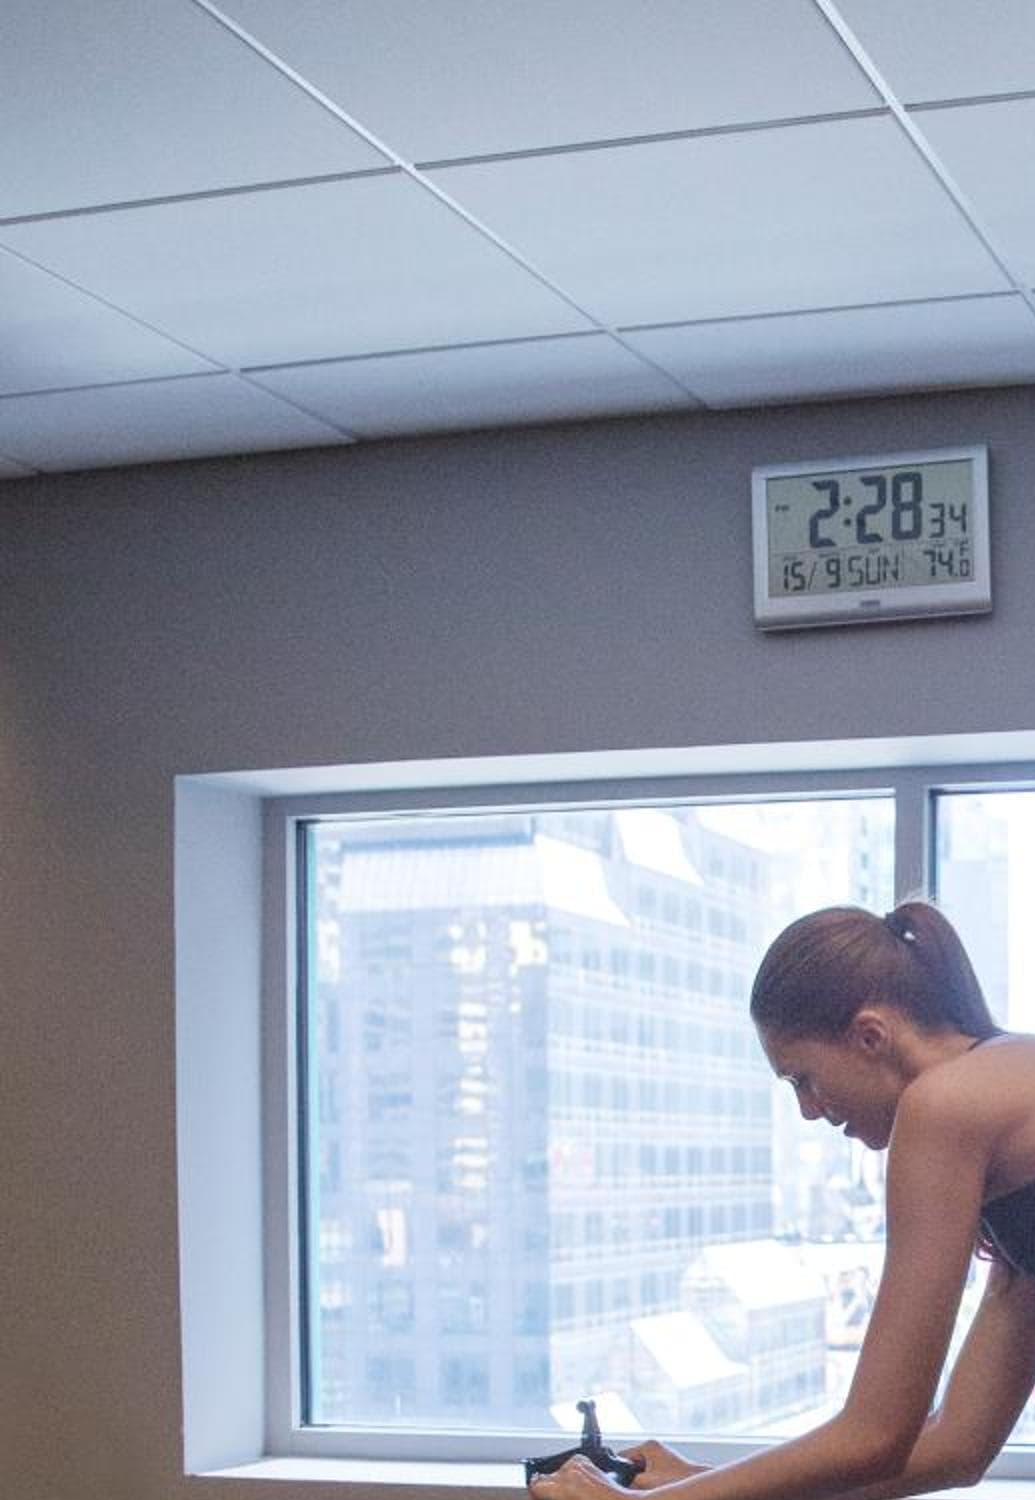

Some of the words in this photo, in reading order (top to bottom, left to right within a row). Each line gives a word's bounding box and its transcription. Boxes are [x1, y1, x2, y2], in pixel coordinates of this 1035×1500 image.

[809, 472, 923, 548] 2:28
[929, 503, 967, 538] 34
[847, 555, 900, 587] SUN
